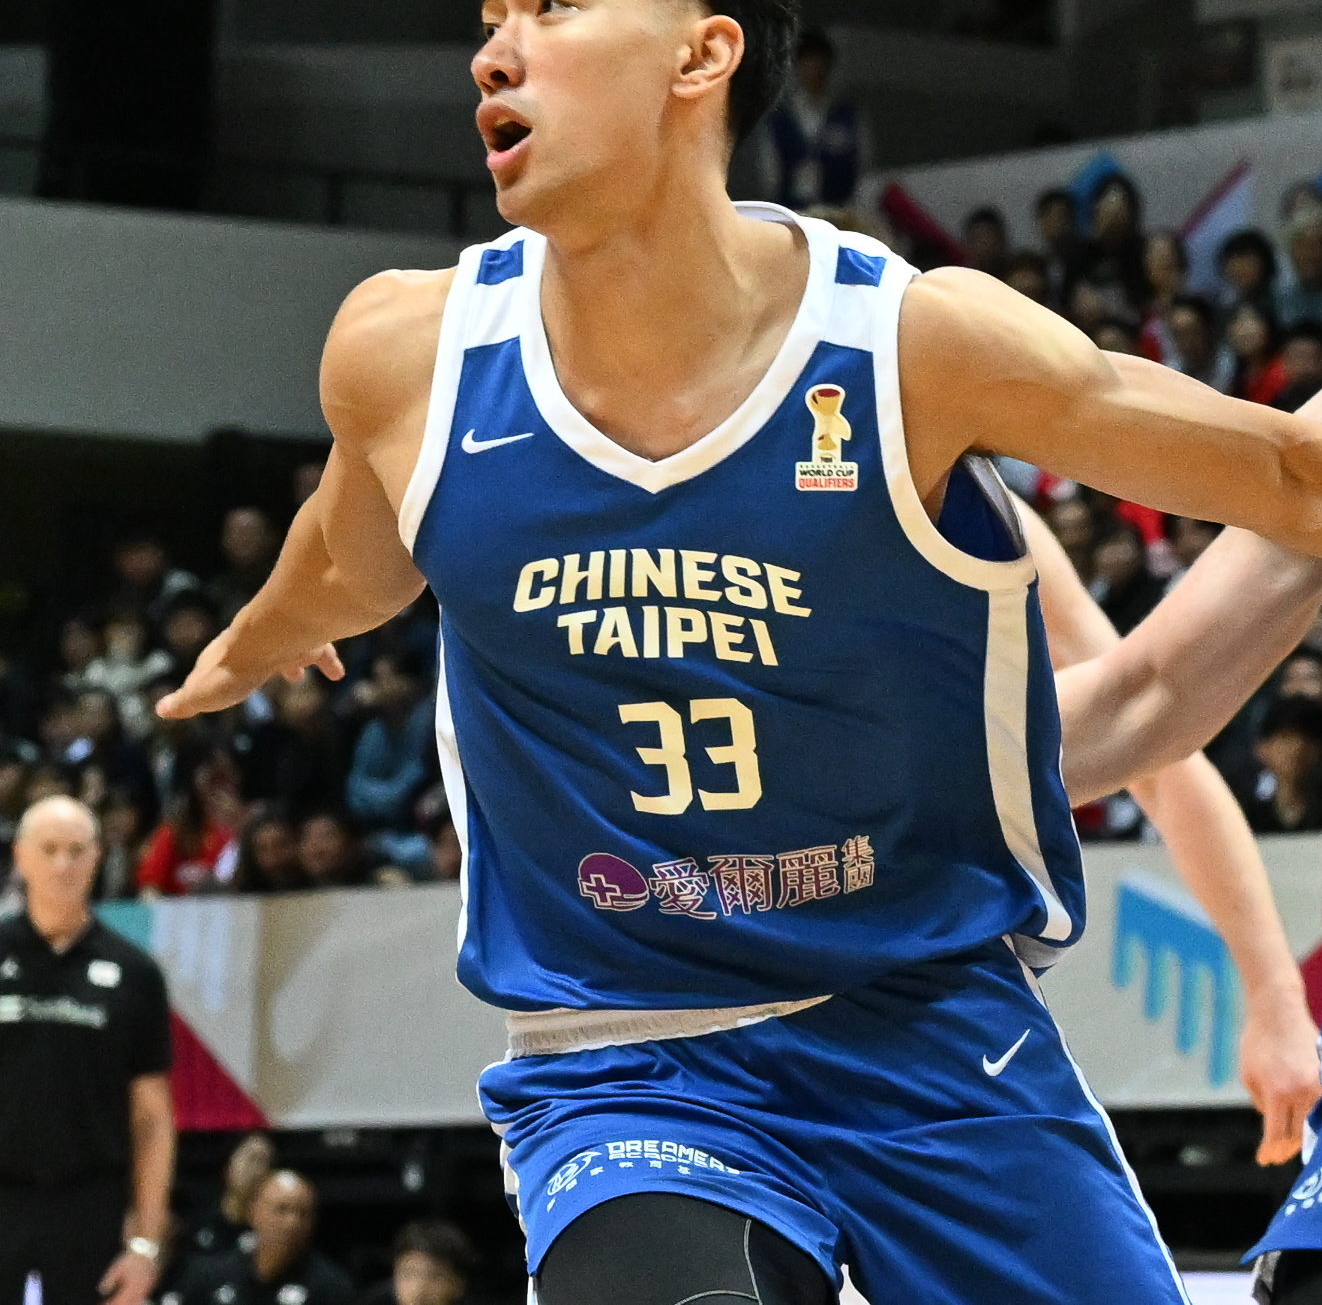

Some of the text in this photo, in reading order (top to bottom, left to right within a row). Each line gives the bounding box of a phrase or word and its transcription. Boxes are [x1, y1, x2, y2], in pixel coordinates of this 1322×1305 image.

[798, 477, 855, 489] QUALIFIERS
[799, 469, 855, 477] WORLD CUP
[513, 548, 813, 618] CHINESE
[557, 605, 779, 667] TAIPEI
[617, 698, 763, 815] 33
